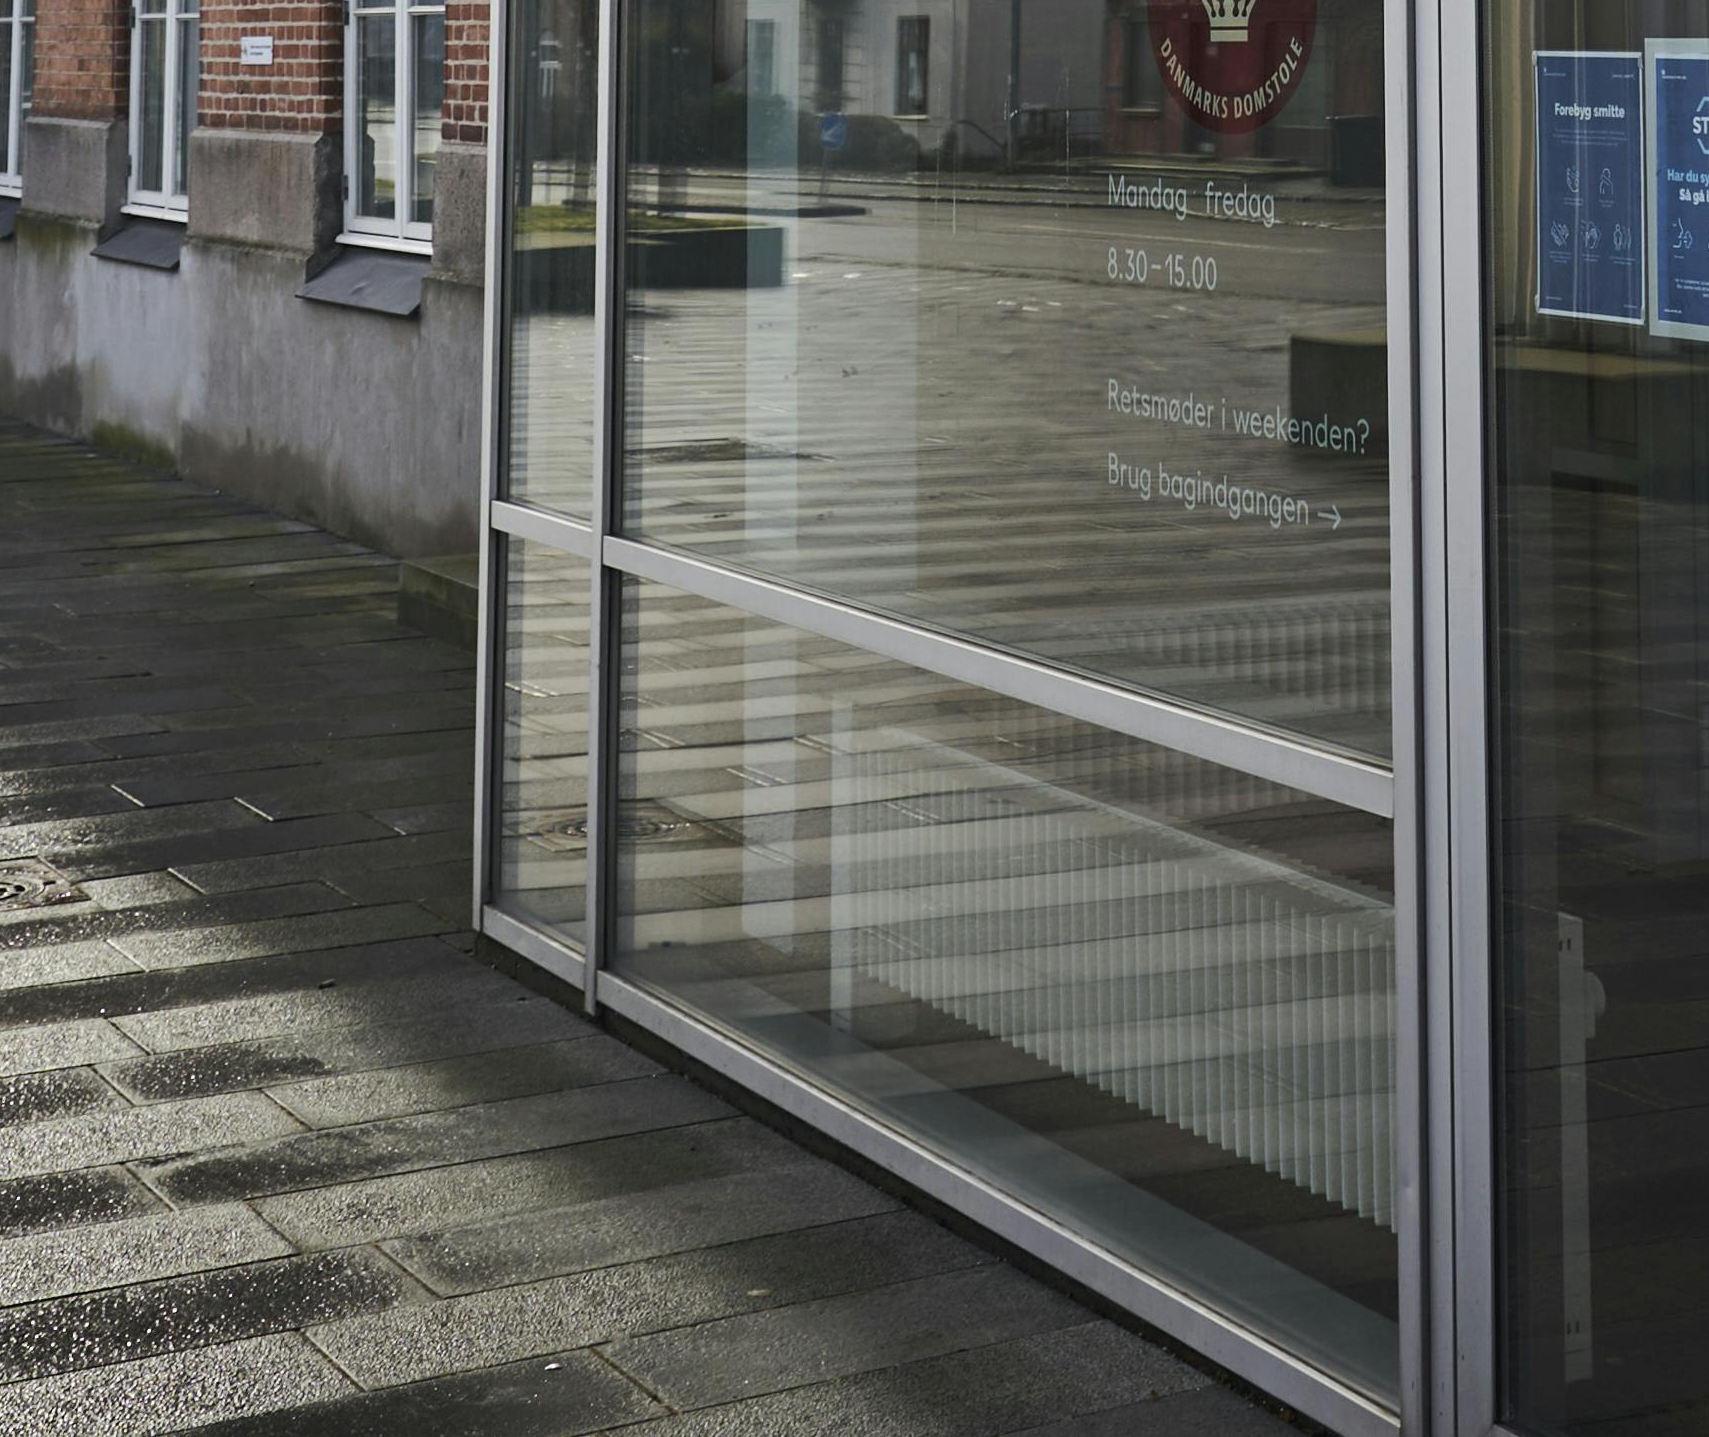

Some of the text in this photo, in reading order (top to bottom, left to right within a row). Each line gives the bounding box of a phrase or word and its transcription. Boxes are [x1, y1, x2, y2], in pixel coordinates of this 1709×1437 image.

[1160, 36, 1303, 119] DANMARKS DOMSTOLE
[1554, 102, 1625, 120] Forebyg smitte
[1108, 174, 1274, 228] Mandag fredag
[1667, 168, 1684, 182] Har
[1686, 169, 1698, 183] du
[1679, 188, 1691, 201] Så
[1693, 189, 1705, 205] gå
[1108, 378, 1370, 454] Retsmøder i weekenden?
[1108, 452, 1309, 529] Brug bagindgangen
